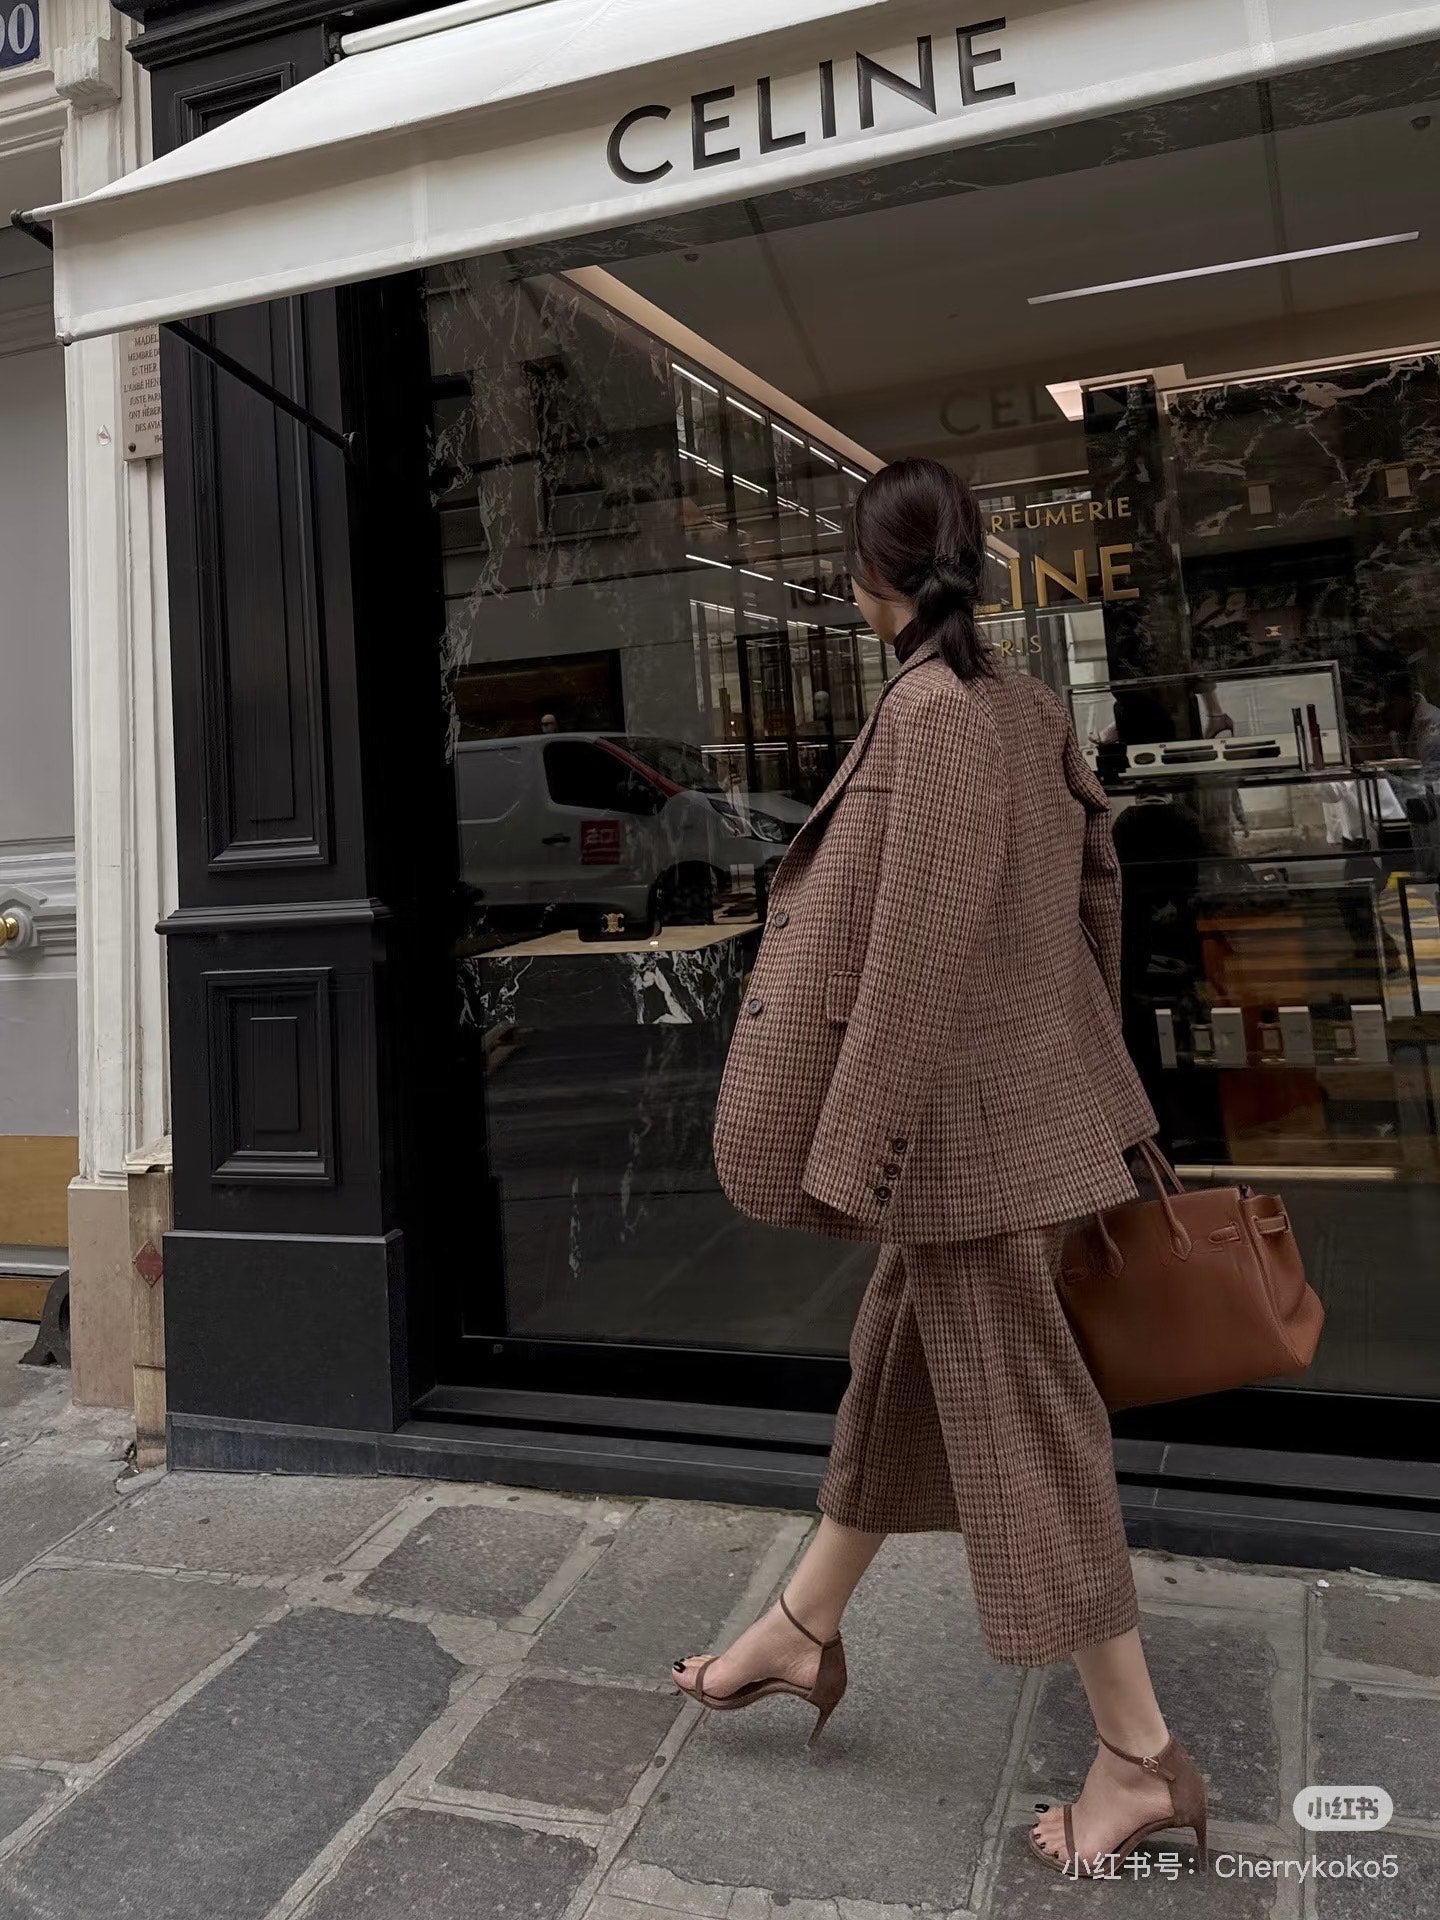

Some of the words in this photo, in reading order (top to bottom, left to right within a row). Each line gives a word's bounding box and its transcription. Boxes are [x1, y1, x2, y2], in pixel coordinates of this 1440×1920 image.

[0, 3, 34, 54] 0
[607, 16, 1016, 185] CELINE
[986, 496, 1132, 535] RFUMERIE
[1000, 634, 1042, 658] RIS
